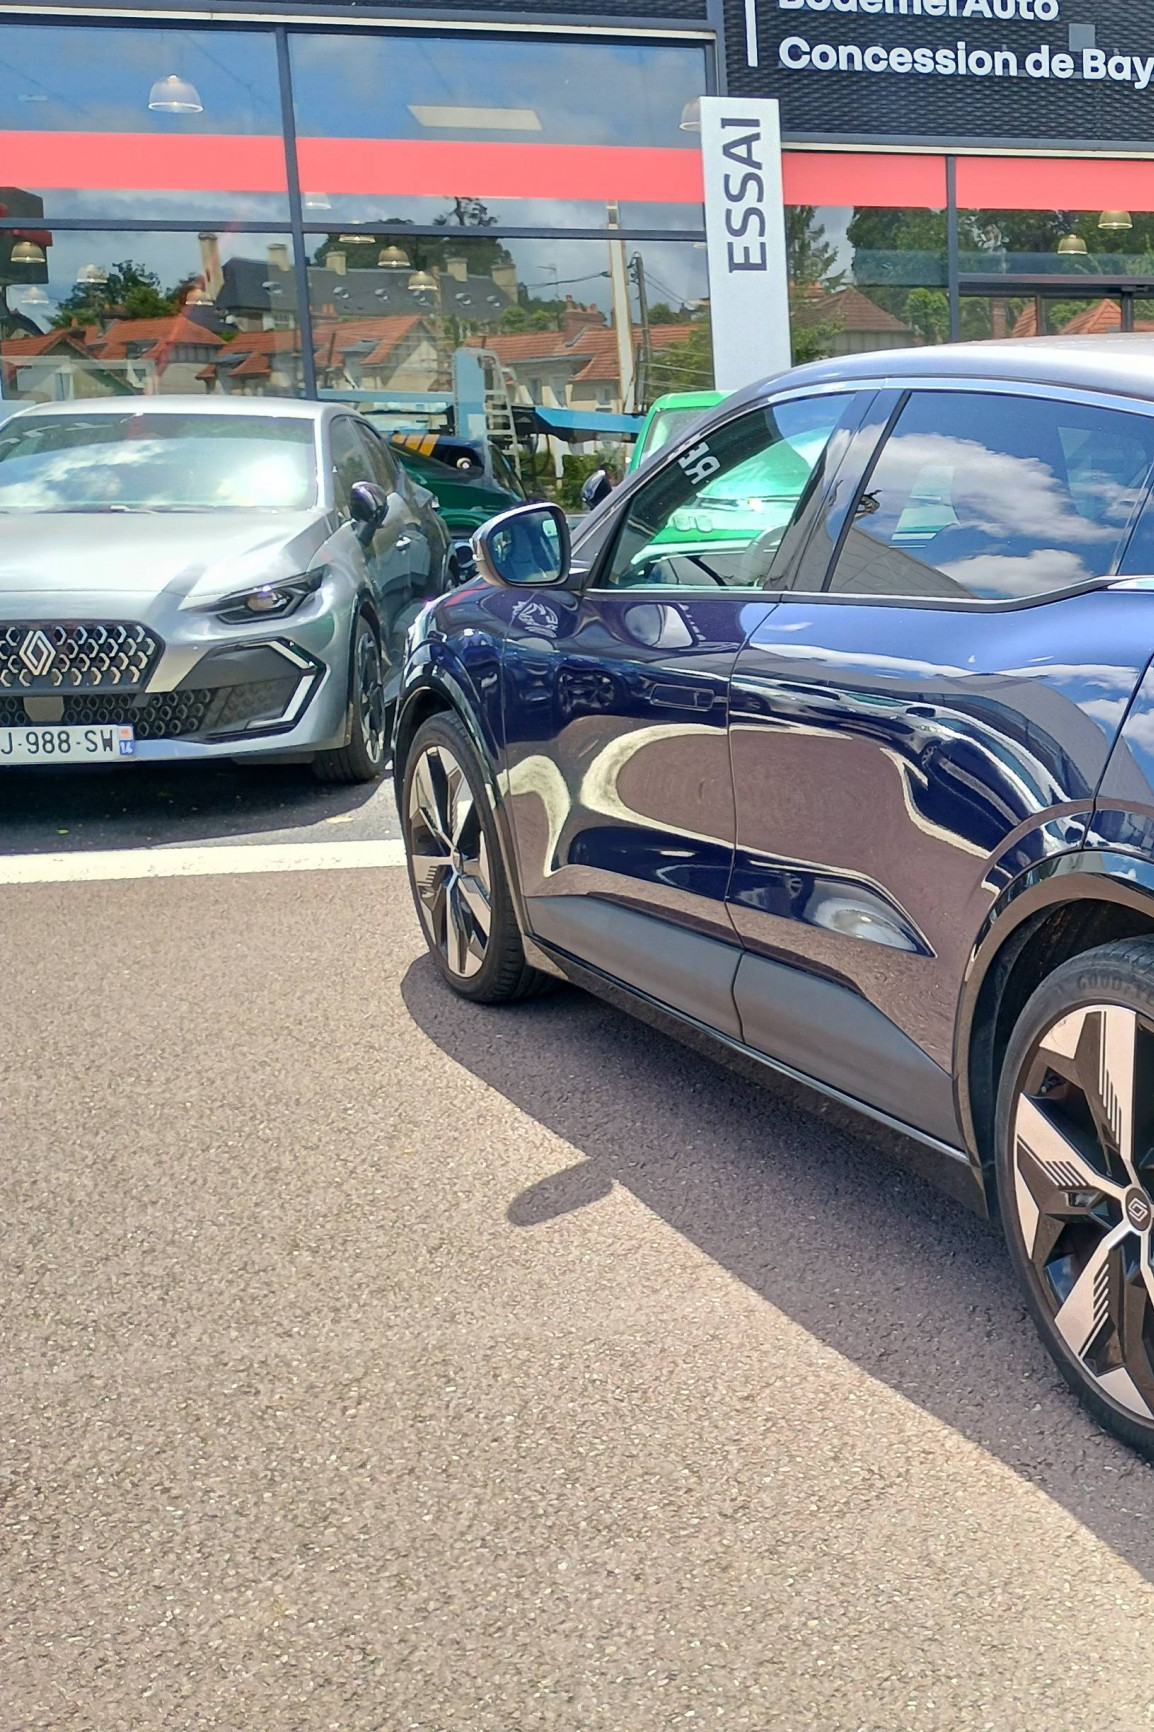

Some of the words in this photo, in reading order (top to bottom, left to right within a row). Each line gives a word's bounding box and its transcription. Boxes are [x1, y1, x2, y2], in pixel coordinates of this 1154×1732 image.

[778, 36, 1018, 77] Concession
[1025, 45, 1075, 78] de
[720, 117, 768, 274] ESSAI
[0, 729, 114, 755] J-988-SW
